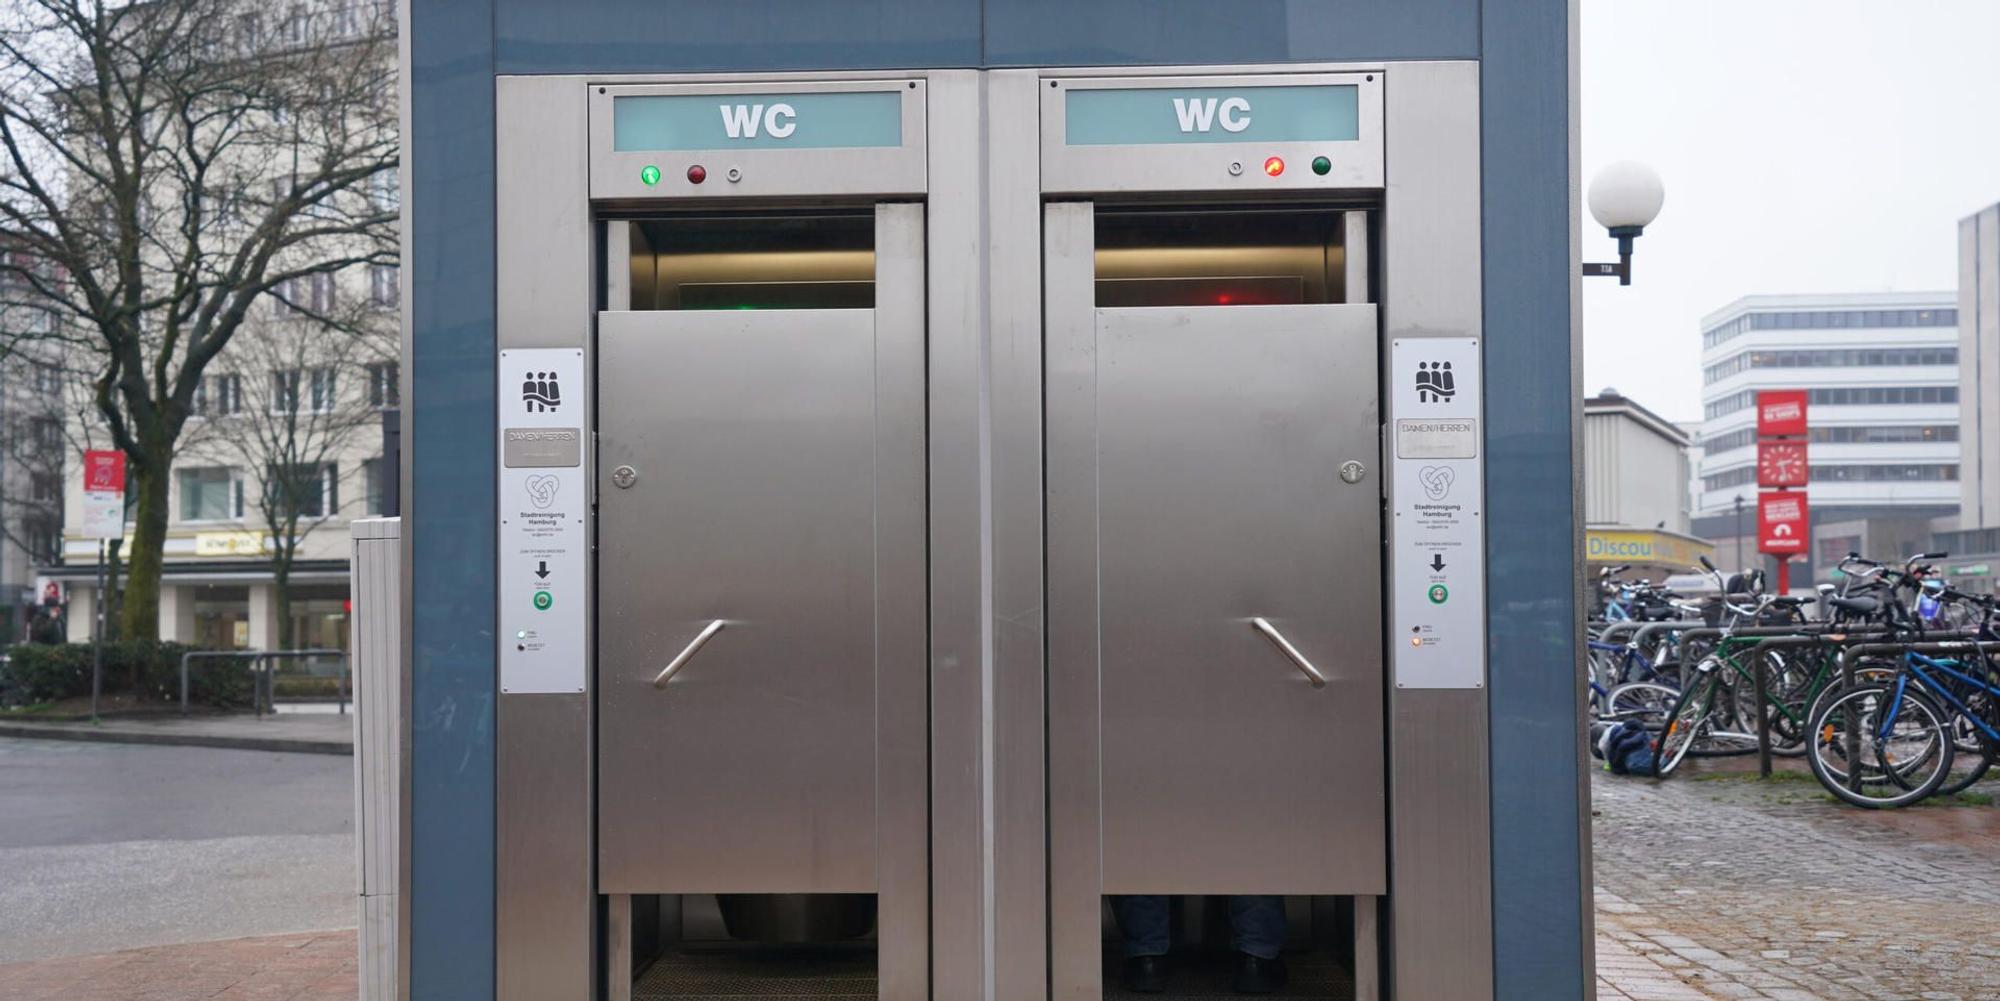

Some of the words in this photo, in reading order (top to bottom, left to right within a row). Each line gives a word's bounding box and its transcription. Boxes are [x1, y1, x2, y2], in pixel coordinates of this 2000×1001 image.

[720, 104, 797, 139] WC
[1173, 97, 1251, 132] WC
[1402, 423, 1471, 432] DAMEN/HERREN
